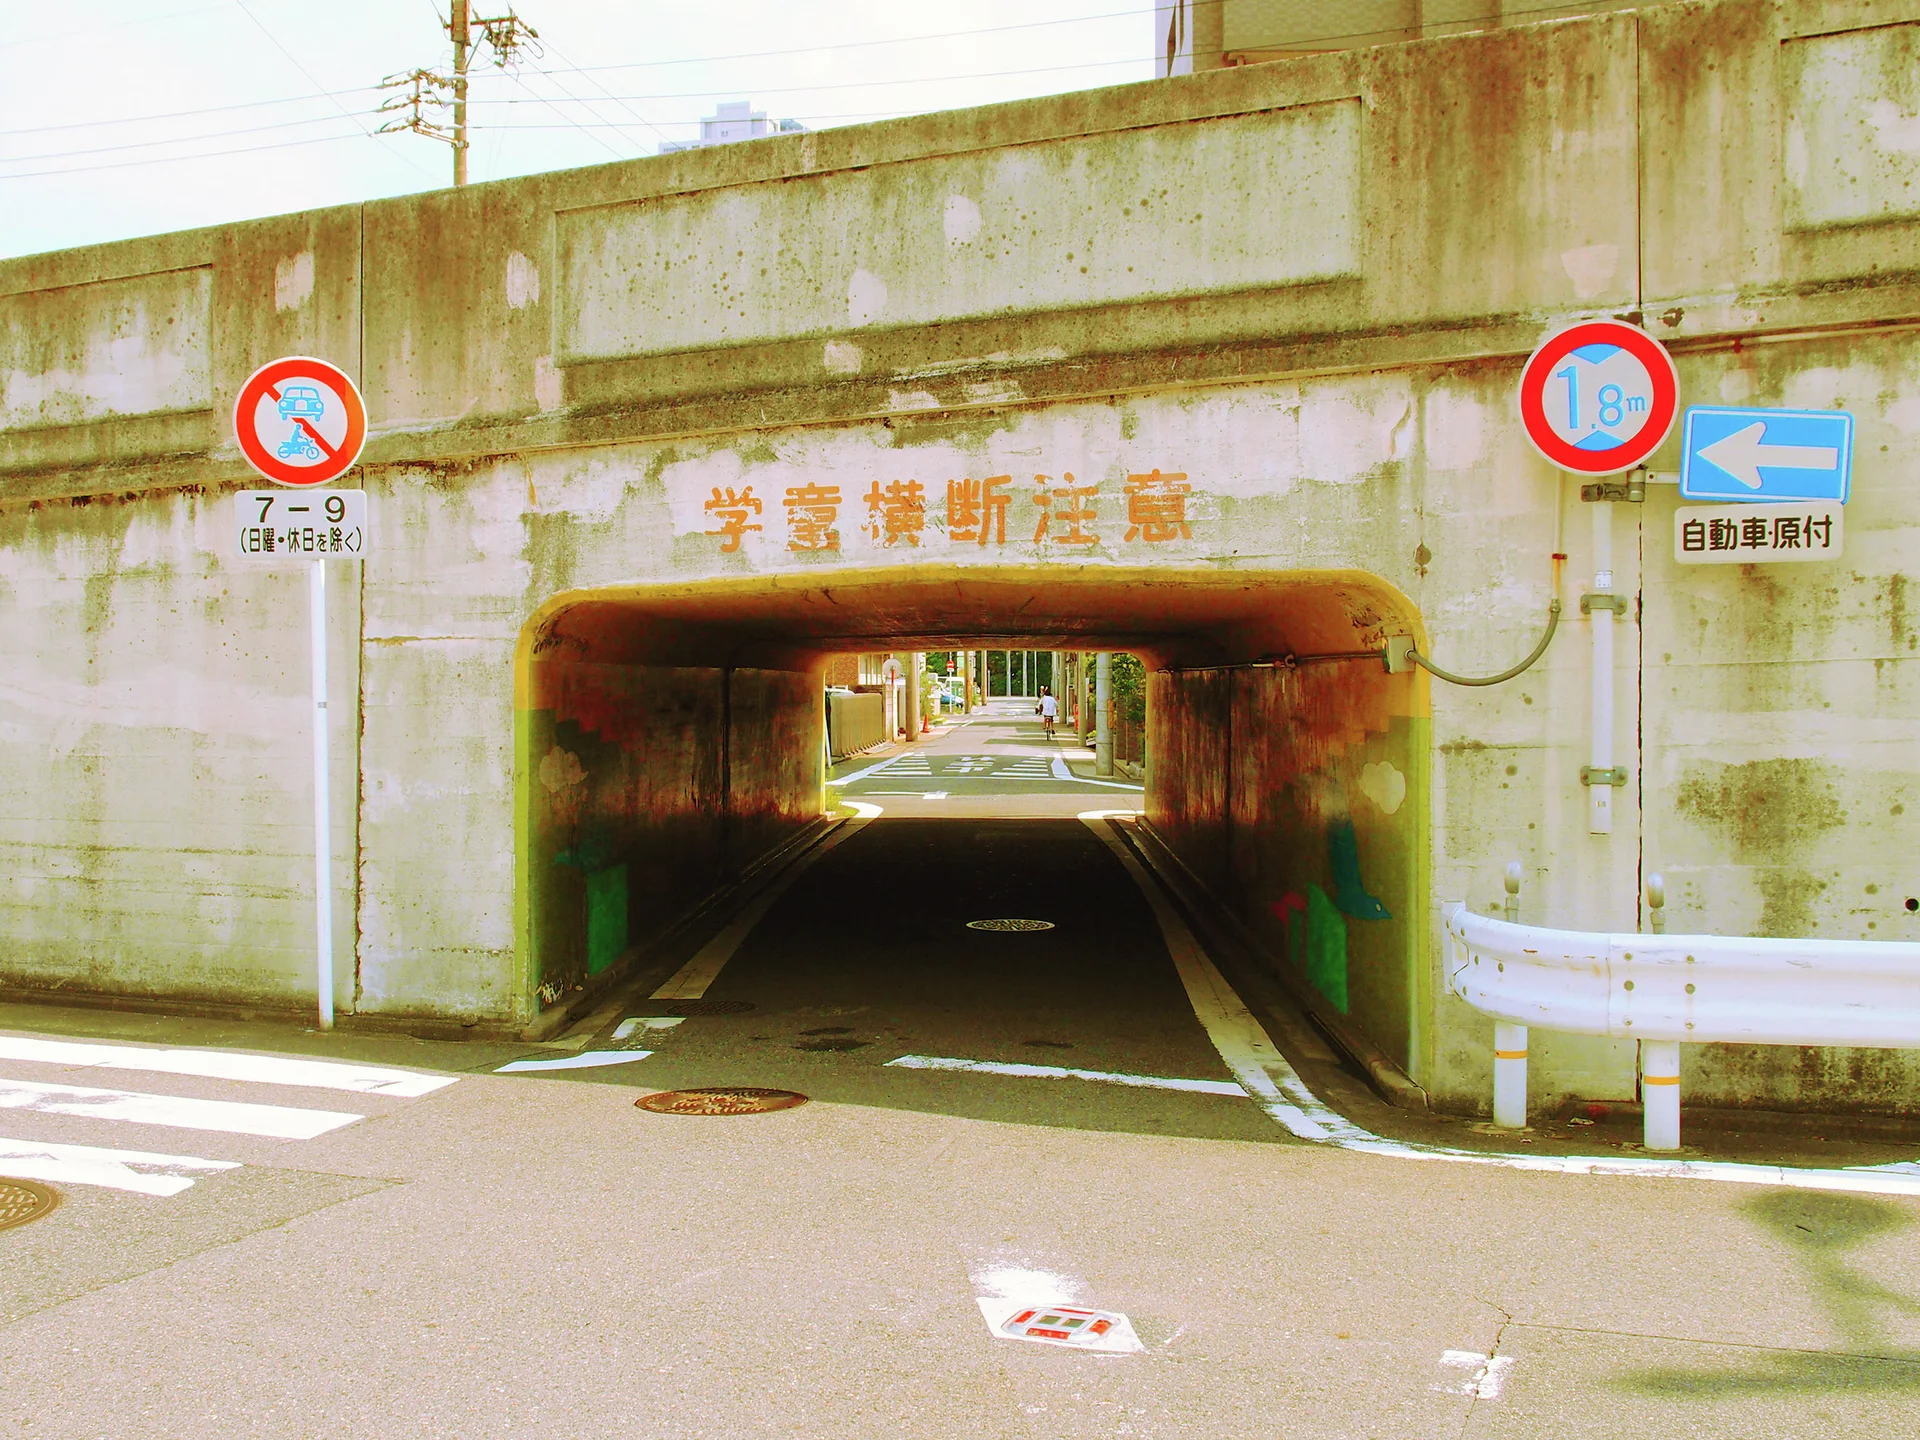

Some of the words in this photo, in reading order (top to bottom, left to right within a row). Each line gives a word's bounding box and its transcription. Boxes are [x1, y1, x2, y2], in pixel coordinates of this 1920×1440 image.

[704, 468, 1194, 552] 学童横断注意
[1683, 514, 1833, 551] 自動車・原付
